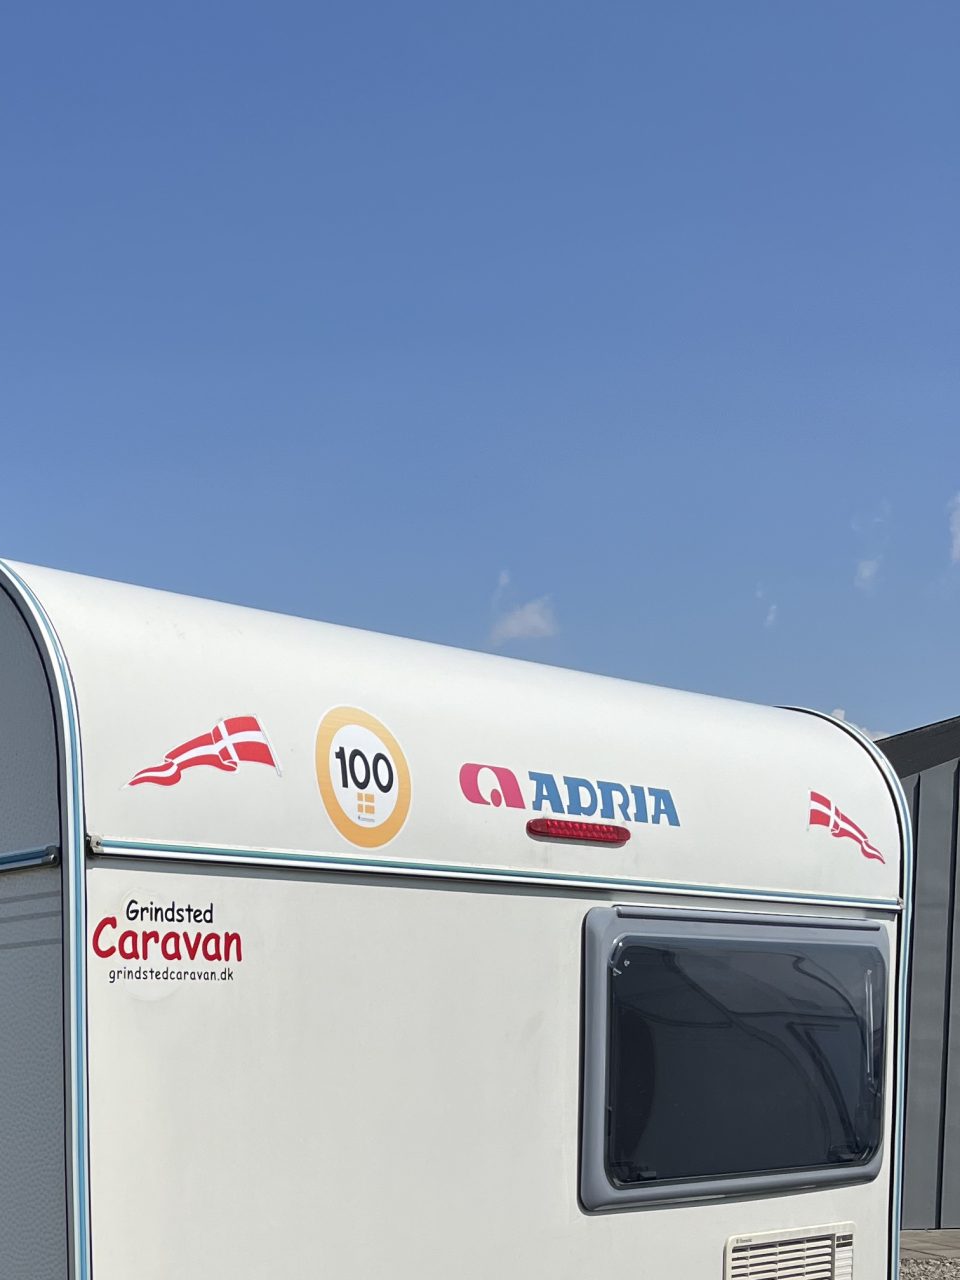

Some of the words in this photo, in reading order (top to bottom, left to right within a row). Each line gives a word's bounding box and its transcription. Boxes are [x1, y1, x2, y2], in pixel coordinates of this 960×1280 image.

[335, 746, 394, 793] 100
[528, 771, 681, 827] ADRIA
[126, 899, 214, 924] Grindsted
[92, 916, 243, 962] Caravan
[108, 966, 234, 984] grindstedcaravan.dk
